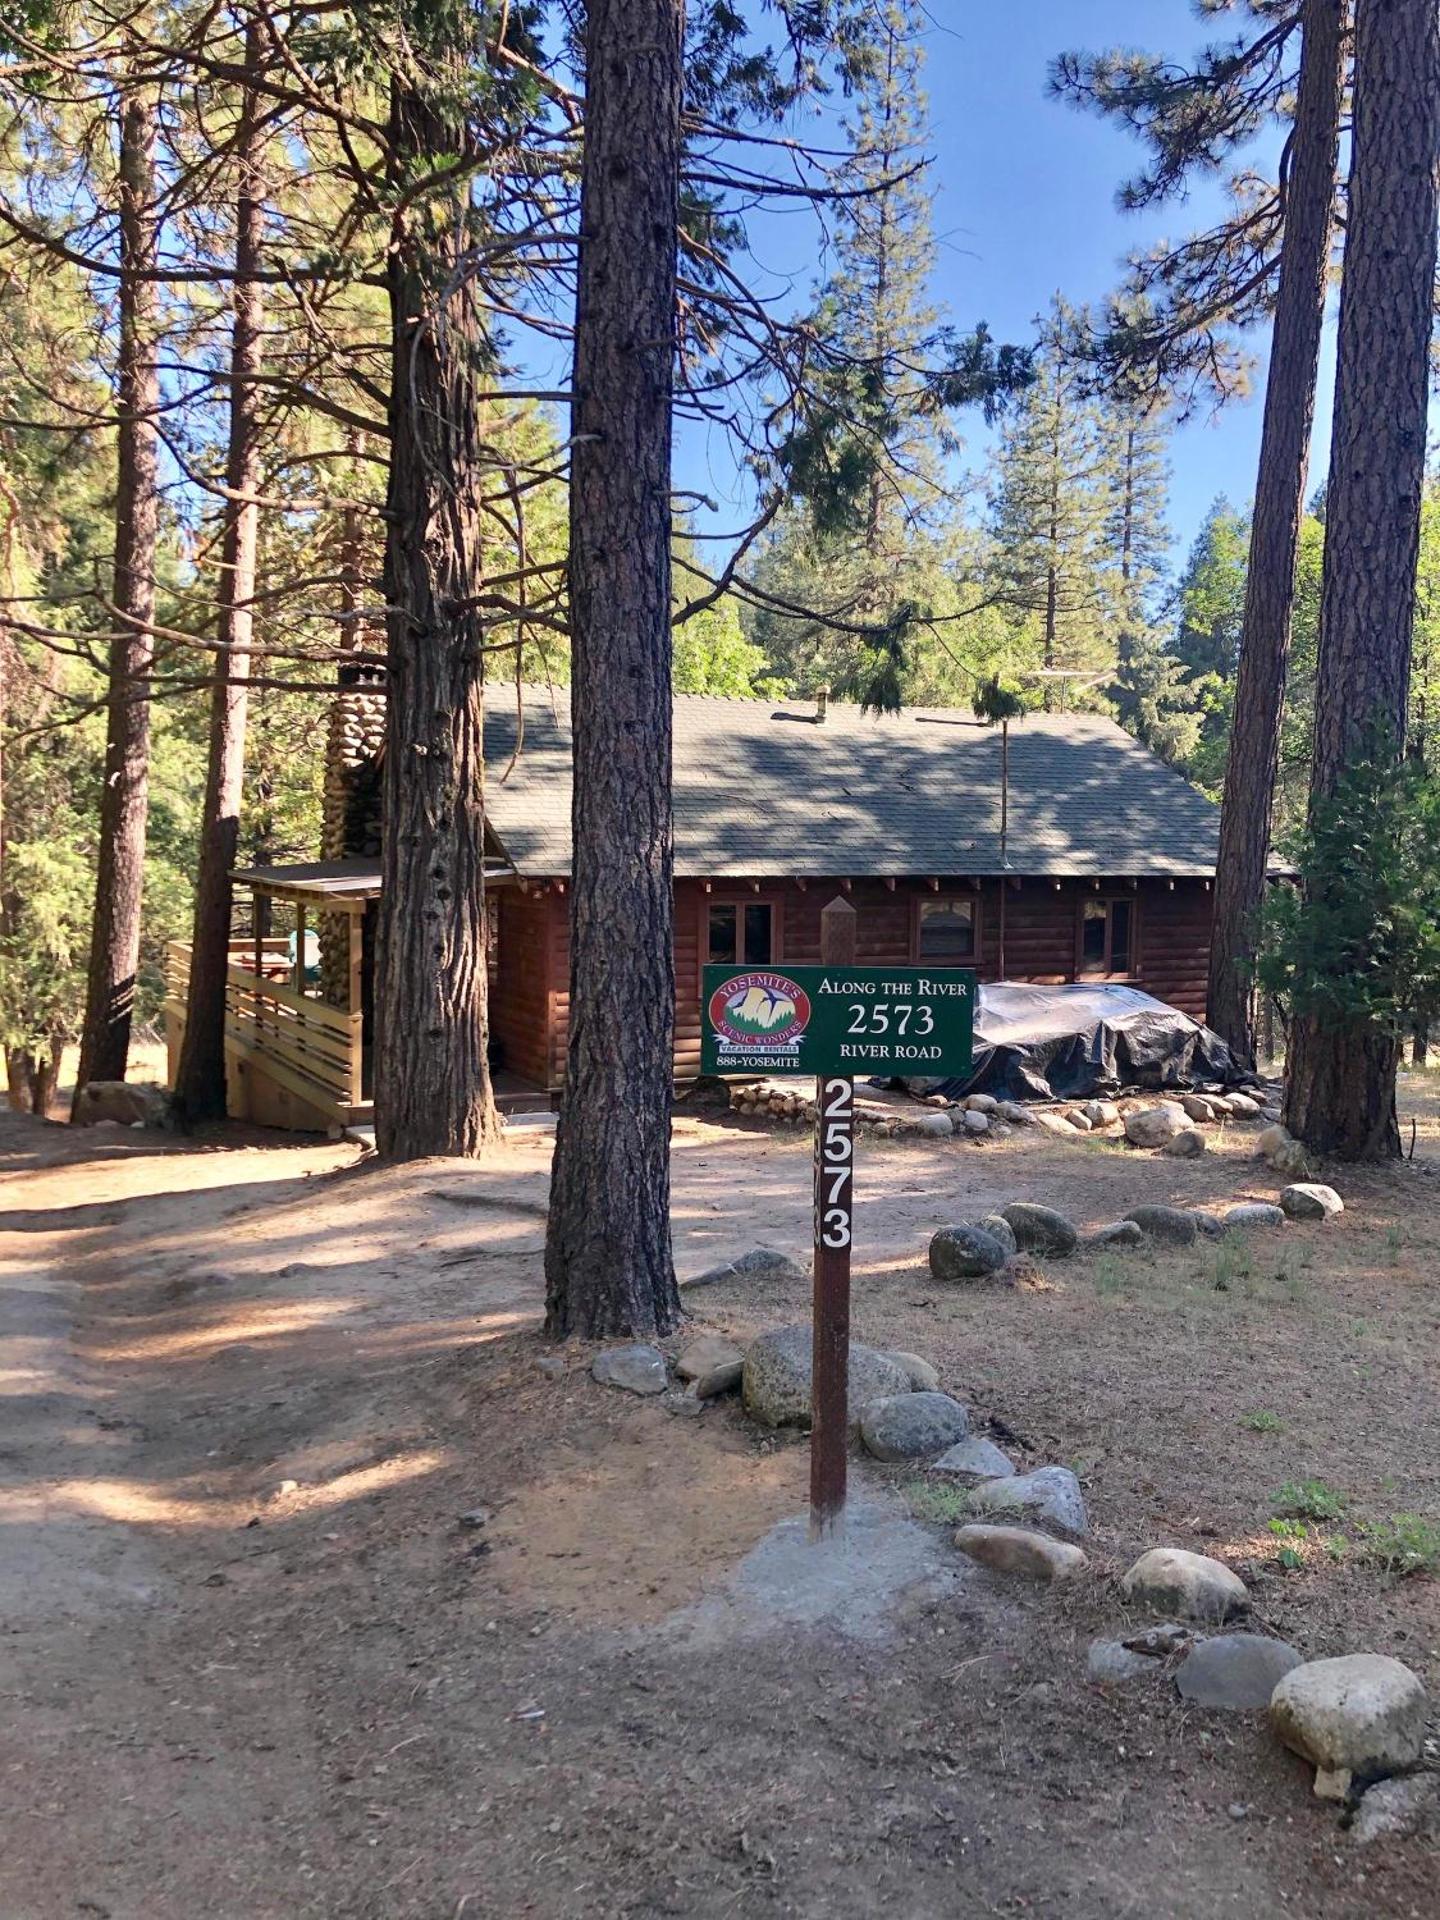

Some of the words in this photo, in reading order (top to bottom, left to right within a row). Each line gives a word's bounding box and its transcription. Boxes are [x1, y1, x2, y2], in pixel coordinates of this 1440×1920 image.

[720, 975, 801, 999] YOSEMITE'S
[881, 982, 912, 995] THE
[847, 1003, 935, 1035] 2573
[719, 1020, 754, 1044] SCENIC
[754, 1020, 802, 1044] WONDERS
[716, 1056, 800, 1068] 888-YOSEMITE
[840, 1044, 890, 1058] RIVER
[894, 1046, 943, 1059] ROAD
[823, 1078, 852, 1248] 2573
